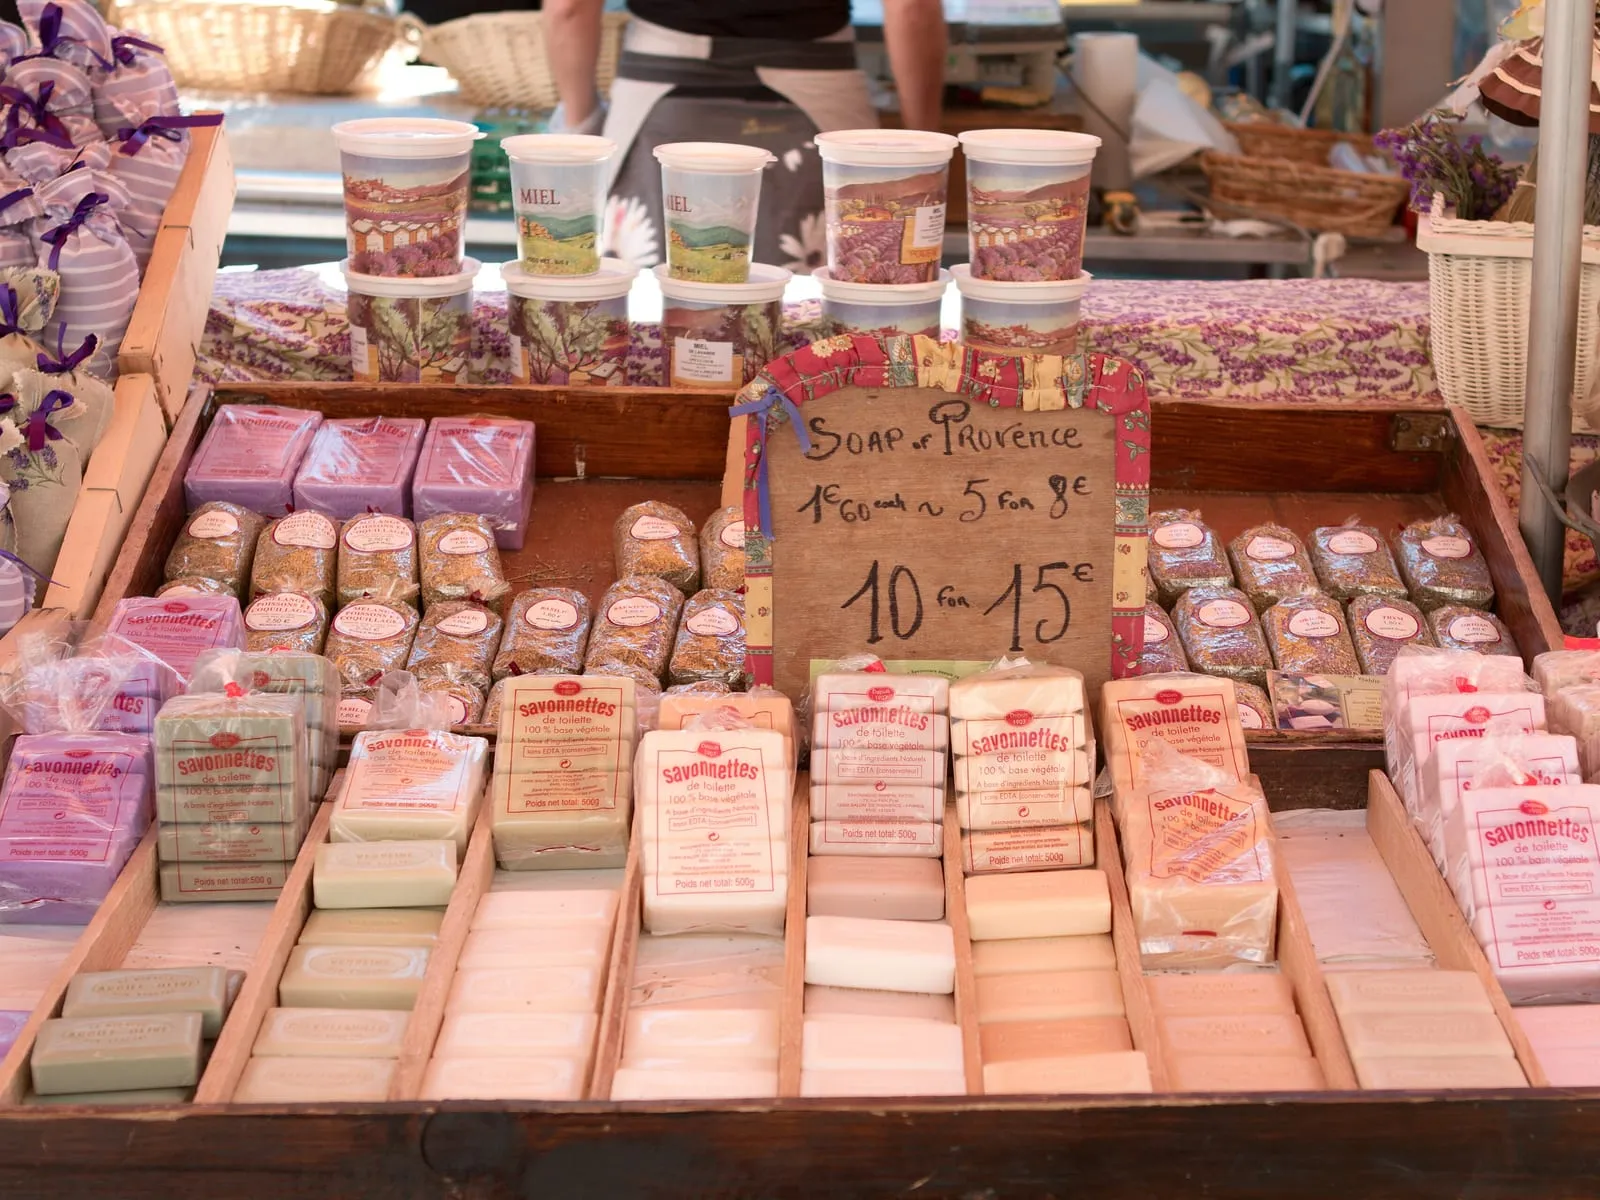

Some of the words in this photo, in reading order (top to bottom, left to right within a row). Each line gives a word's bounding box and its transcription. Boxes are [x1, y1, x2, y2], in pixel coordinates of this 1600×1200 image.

[520, 188, 560, 205] MIEL
[804, 417, 904, 461] SOAP
[873, 494, 907, 513] each
[959, 479, 990, 522] 5
[840, 560, 924, 645] 10
[345, 610, 384, 618] POISSONS
[127, 613, 217, 630] savonnettes
[519, 697, 616, 718] savonnettes
[542, 714, 556, 724] de
[559, 715, 592, 725] toilette
[832, 705, 929, 732] savonnettes
[1126, 705, 1222, 732] savonnettes
[524, 725, 541, 734] 100
[543, 725, 551, 733] %
[553, 725, 573, 734] base
[576, 725, 610, 734] végétale
[856, 728, 869, 737] de
[872, 728, 905, 738] toilette
[1151, 728, 1165, 737] de
[1167, 726, 1201, 736] toilette
[838, 739, 855, 749] 100
[867, 740, 887, 750] base
[889, 740, 925, 752] végétale
[972, 727, 1069, 756] savonnettes
[1186, 735, 1221, 745] végétale
[177, 748, 275, 776] savonnettes
[996, 752, 1009, 763] de
[1013, 751, 1047, 762] toilette
[25, 760, 121, 778] savonnettes
[663, 758, 759, 785] savonnettes
[979, 766, 996, 775] 100
[998, 765, 1006, 774] %
[1008, 765, 1029, 774] base
[1031, 764, 1066, 776] végétale
[202, 774, 215, 783] de
[218, 773, 251, 783] toilette
[185, 787, 201, 795] 100
[213, 787, 234, 796] base
[236, 784, 271, 795] végétale
[686, 781, 700, 791] de
[703, 782, 736, 792] toilette
[525, 799, 546, 808] Poids
[547, 799, 560, 807] net
[581, 798, 600, 808] 500g
[669, 795, 686, 804] 100
[699, 792, 718, 802] base
[720, 790, 757, 804] végétale
[672, 808, 688, 816] base
[1154, 795, 1249, 822] savonnettes
[1180, 807, 1193, 818] de
[1163, 814, 1180, 823] 100
[842, 828, 863, 838] Poids
[864, 829, 877, 838] net
[878, 829, 897, 838] total:
[898, 829, 917, 840] 500g
[1484, 817, 1589, 847] savonnettes
[69, 848, 88, 858] 500g
[1514, 843, 1529, 853] de
[1532, 843, 1568, 852] toilette
[989, 855, 1010, 865] Poids
[1011, 855, 1024, 864] net
[1025, 854, 1044, 863] total:
[1045, 853, 1064, 864] 500g
[1495, 857, 1515, 867] 100
[1528, 857, 1550, 865] base
[1553, 856, 1590, 867] végétale
[194, 877, 215, 886] Poids
[218, 877, 230, 885] net
[675, 879, 698, 889] Poids
[699, 879, 712, 887] net
[713, 878, 733, 887] total:
[735, 877, 755, 889] 500g
[1521, 884, 1541, 892] EDTA
[1517, 950, 1541, 961] Poids
[1543, 950, 1556, 959] net
[1558, 948, 1577, 958] total:
